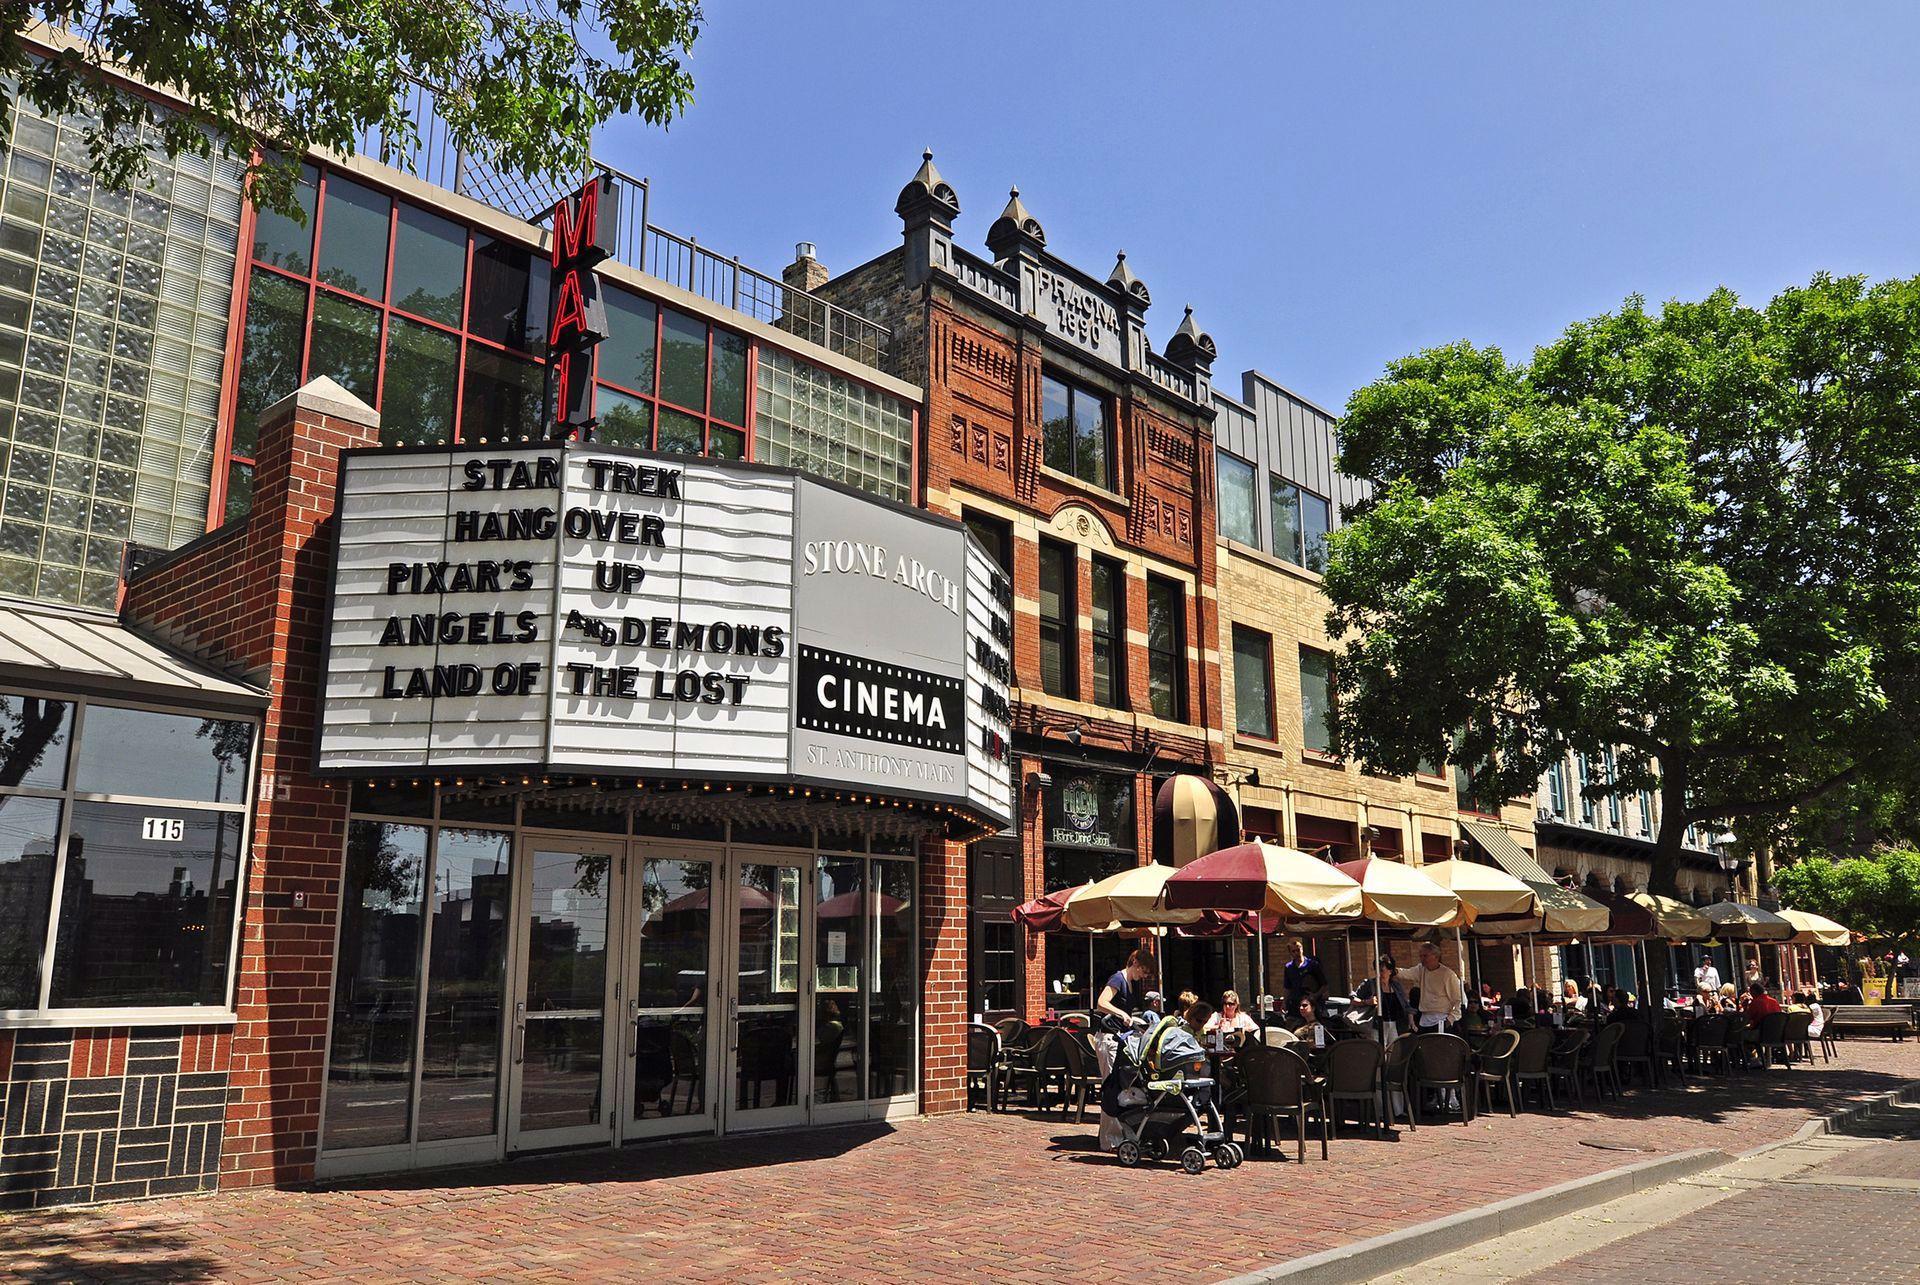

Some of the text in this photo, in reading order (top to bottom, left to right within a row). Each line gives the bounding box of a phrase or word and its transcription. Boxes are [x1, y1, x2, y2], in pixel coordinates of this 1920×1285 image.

[550, 178, 598, 442] MAI
[1038, 266, 1121, 336] PRACNA
[1057, 306, 1101, 350] 1890
[462, 456, 682, 500] STAR TREK
[387, 558, 646, 595] PIXAR'S UP
[804, 540, 888, 579] STONE
[893, 554, 960, 616] ARCH
[379, 609, 784, 658] ANGELS AND DEMONS
[382, 662, 750, 706] LAND OF THE LOST
[816, 673, 947, 730] CINEMA
[806, 743, 955, 784] ST. ANTHONY MAIN
[147, 819, 182, 839] 115
